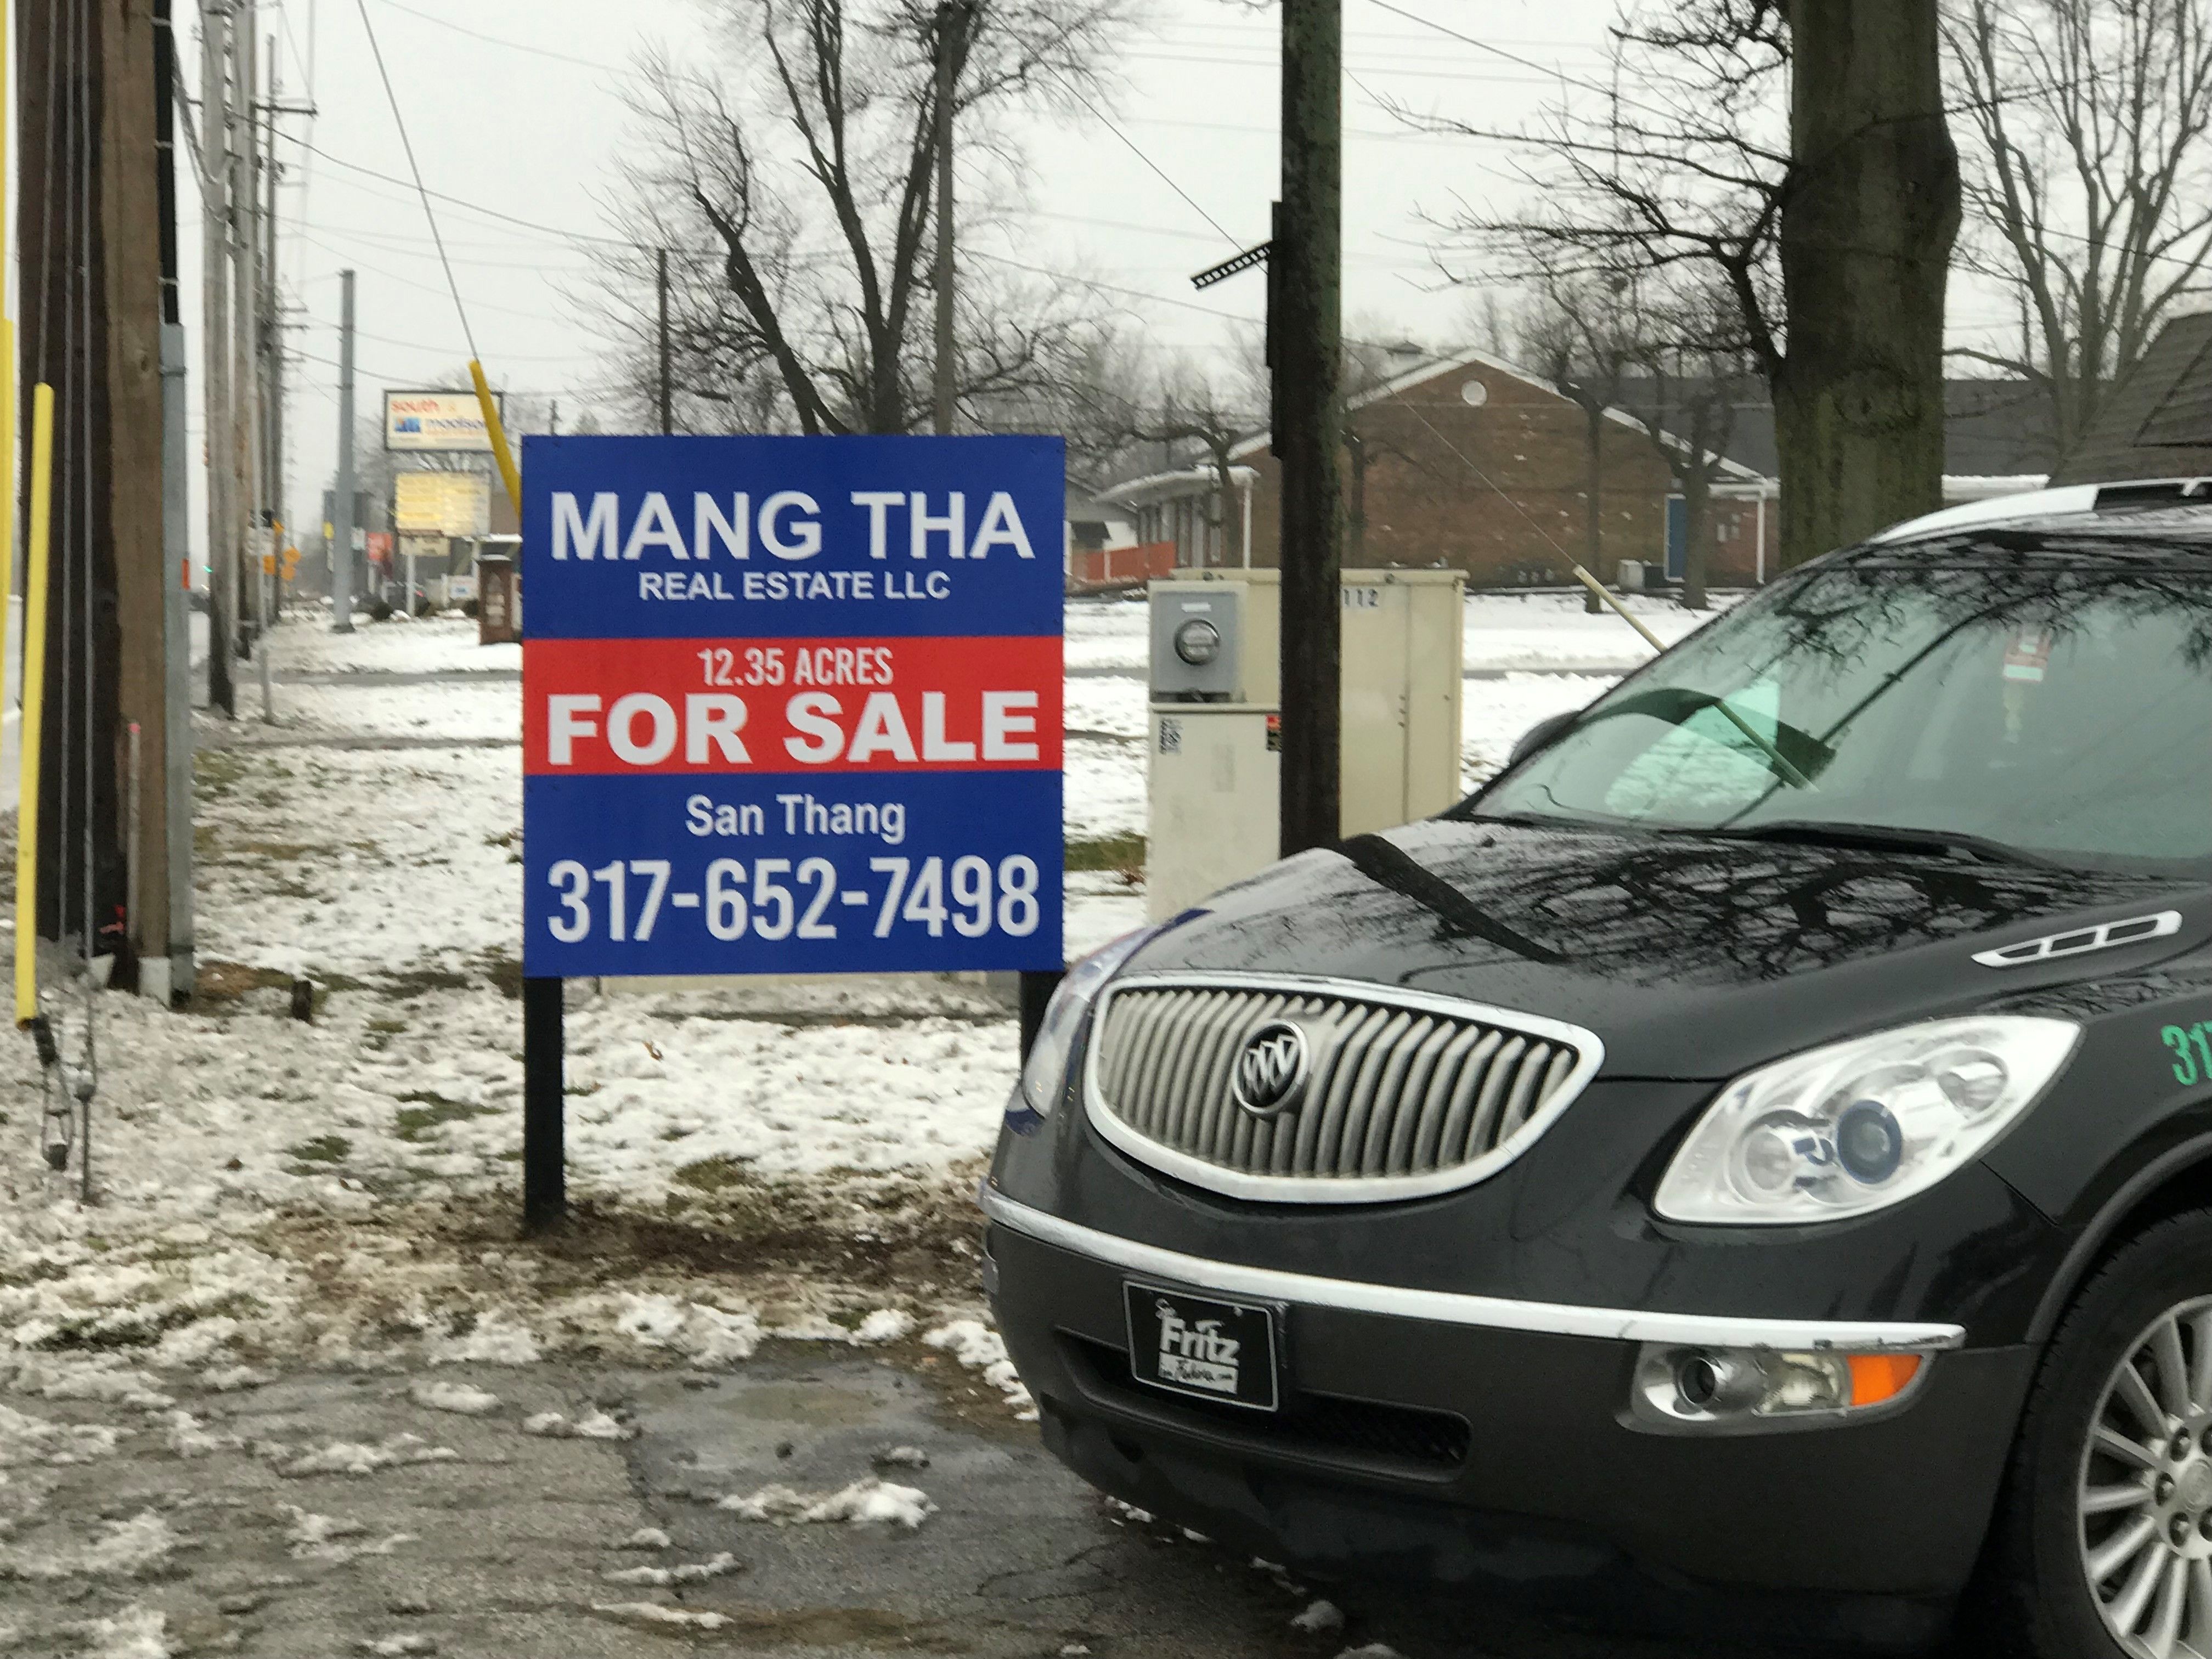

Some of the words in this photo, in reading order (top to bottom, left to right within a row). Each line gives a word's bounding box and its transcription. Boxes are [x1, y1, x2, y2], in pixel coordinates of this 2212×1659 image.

[552, 491, 821, 560] MANG
[851, 492, 1035, 559] THA
[639, 572, 734, 600] REAL
[743, 572, 873, 600] ESTATE
[884, 571, 950, 599] LLC
[697, 648, 785, 686] 12.35
[794, 647, 893, 685] ACRES
[548, 693, 752, 765] FOR
[783, 691, 1039, 764] SALE
[686, 794, 764, 836] San
[776, 794, 905, 844] Thang
[548, 855, 1039, 943] 317-652-7498
[2162, 1022, 2212, 1085] 31
[1159, 1317, 1240, 1365] Fritz
